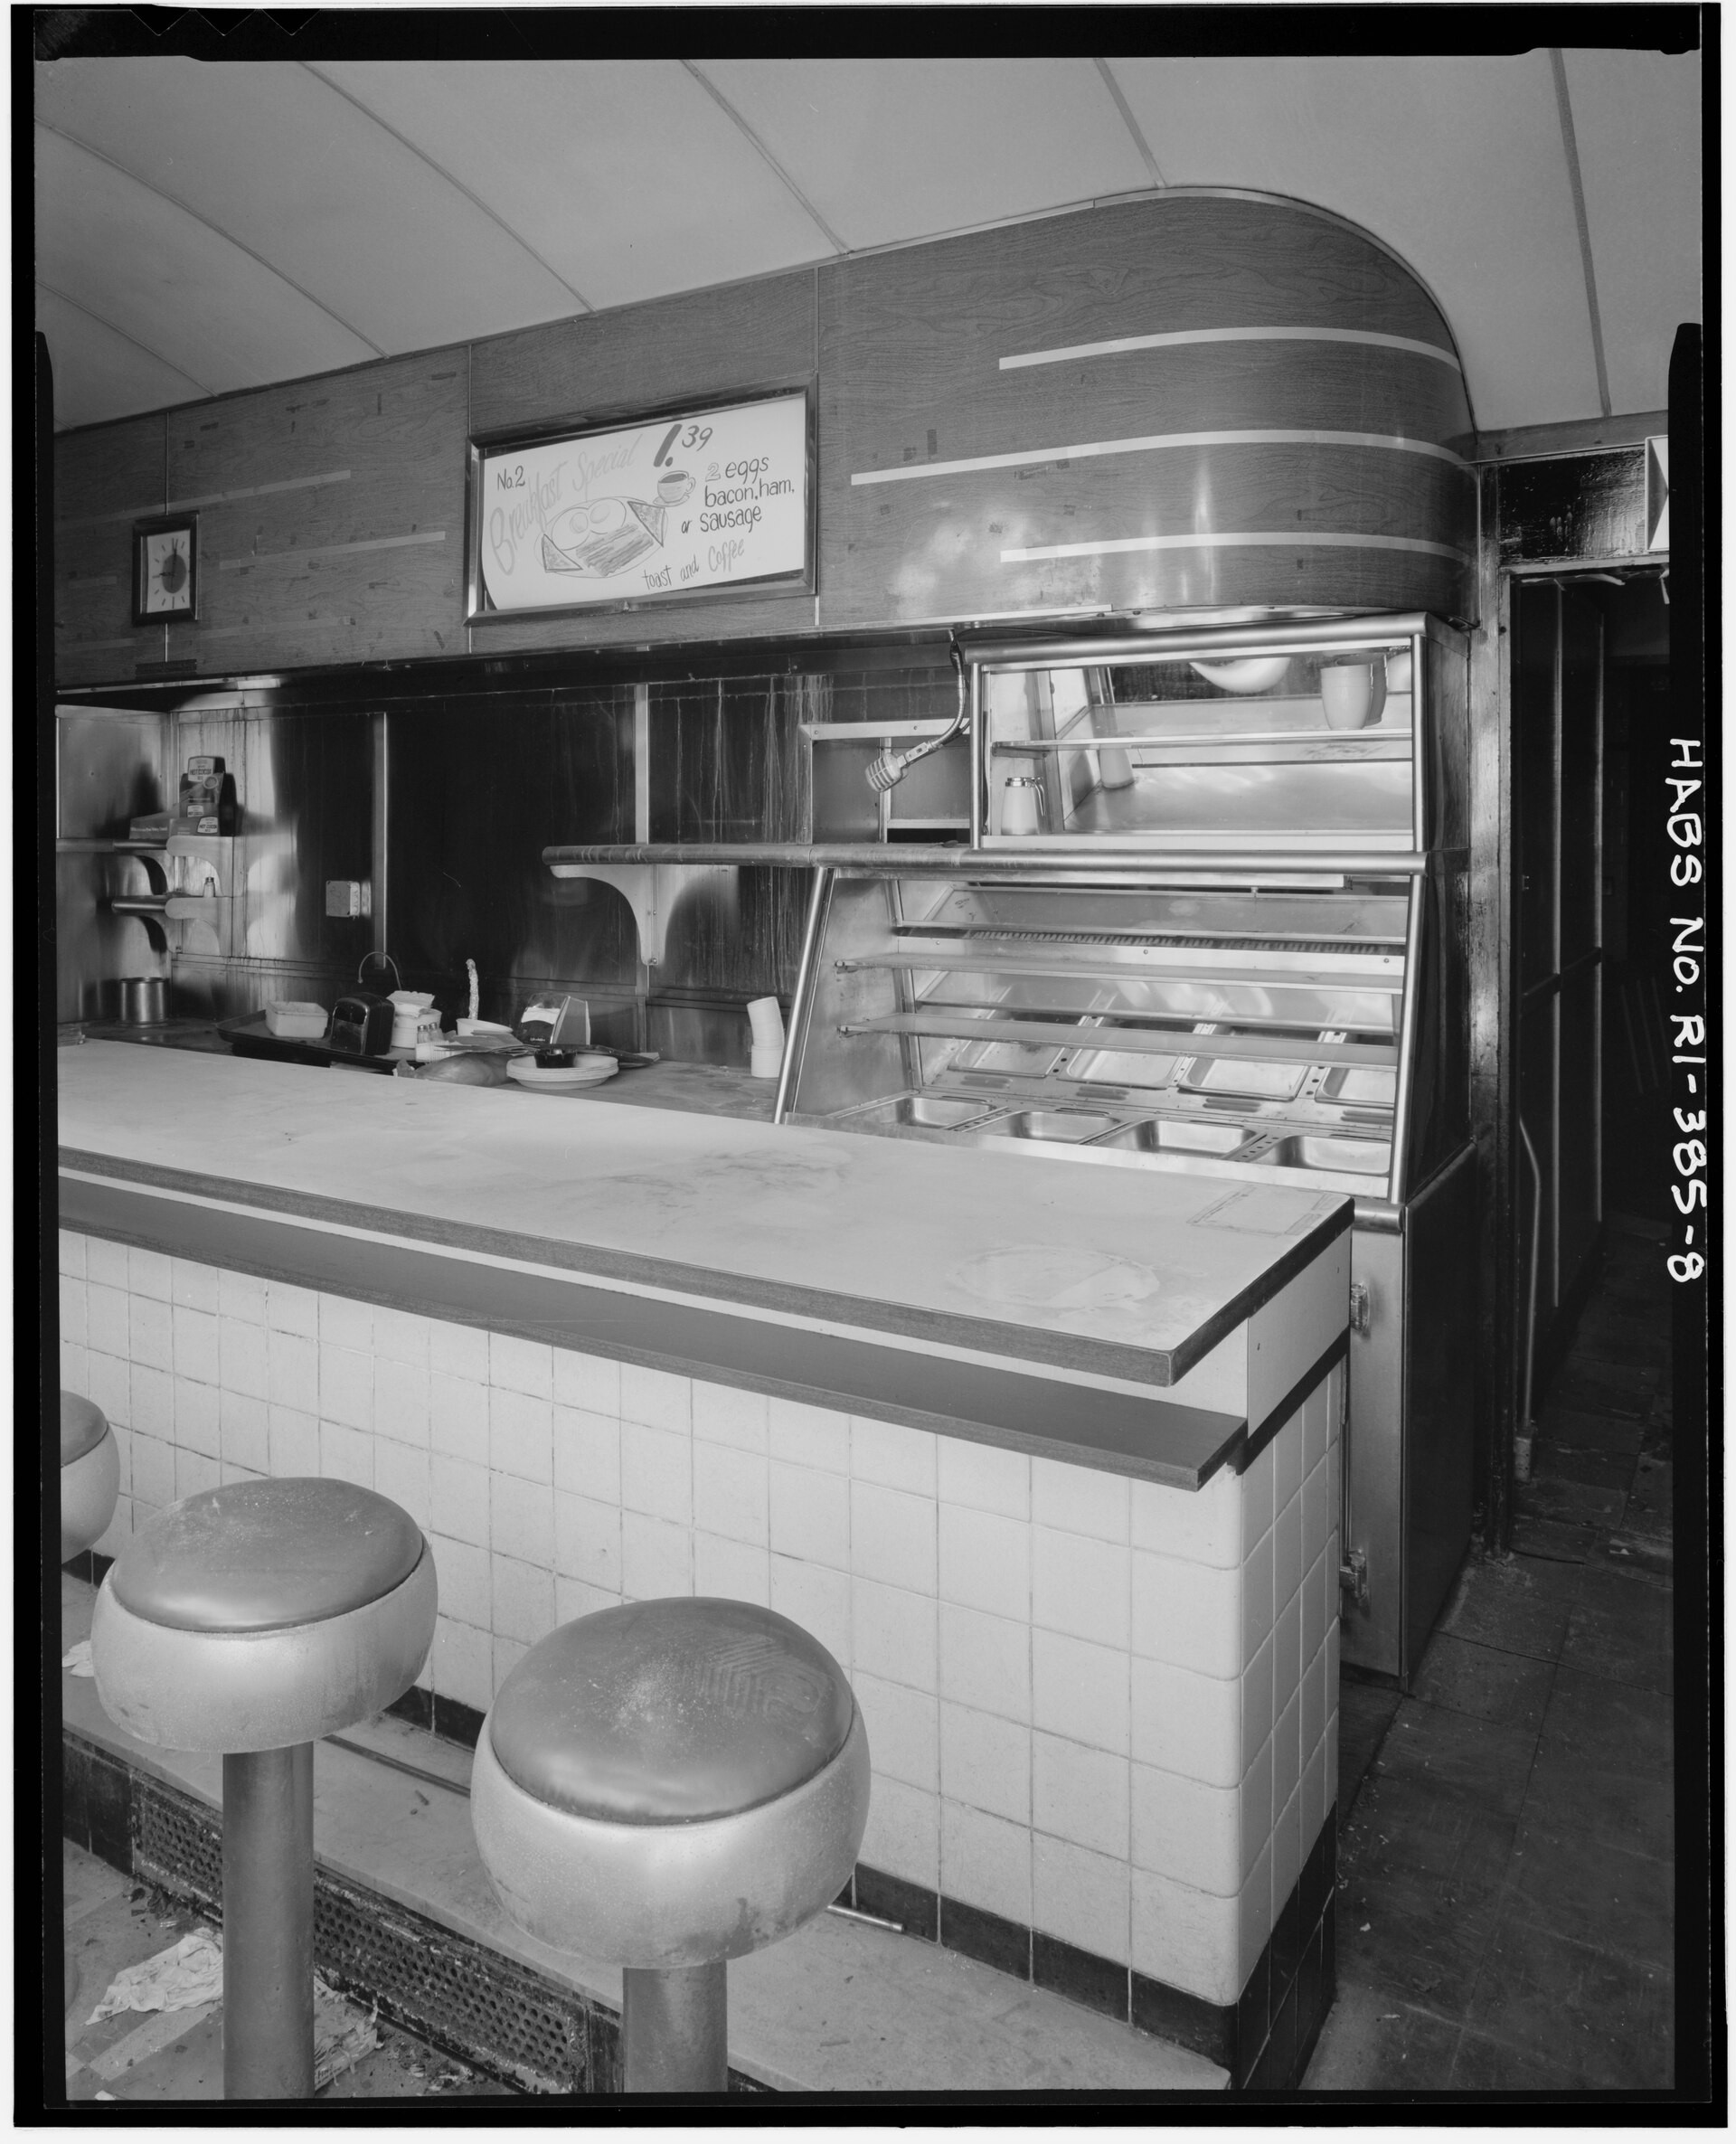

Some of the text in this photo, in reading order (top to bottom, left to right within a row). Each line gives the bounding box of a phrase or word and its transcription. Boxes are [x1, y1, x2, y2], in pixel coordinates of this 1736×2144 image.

[704, 456, 769, 485] 2 eggs
[489, 433, 644, 577] Breakfast Special
[681, 519, 693, 534] or
[642, 564, 673, 590] toast
[680, 553, 700, 581] and
